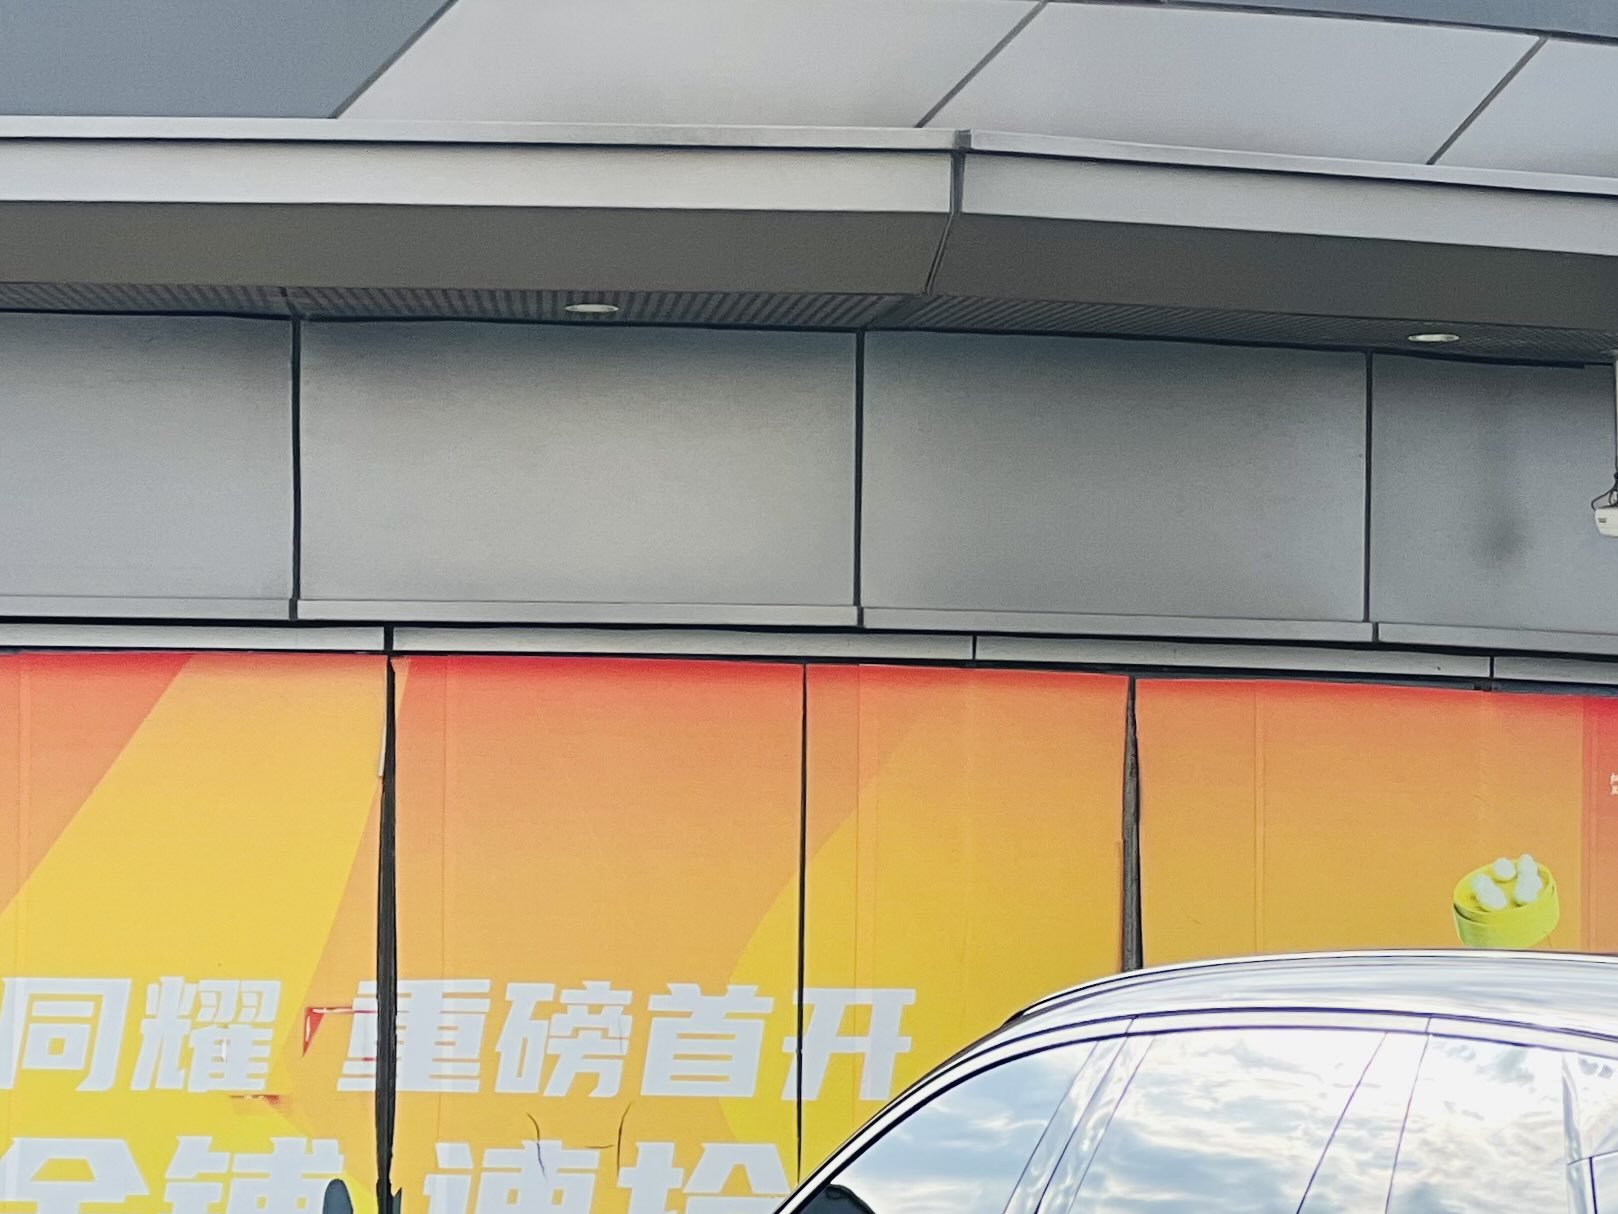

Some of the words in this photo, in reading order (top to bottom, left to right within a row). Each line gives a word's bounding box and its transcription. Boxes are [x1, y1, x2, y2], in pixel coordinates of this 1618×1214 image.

[0, 976, 282, 1092] 同耀
[337, 979, 917, 1101] 重磅首开
